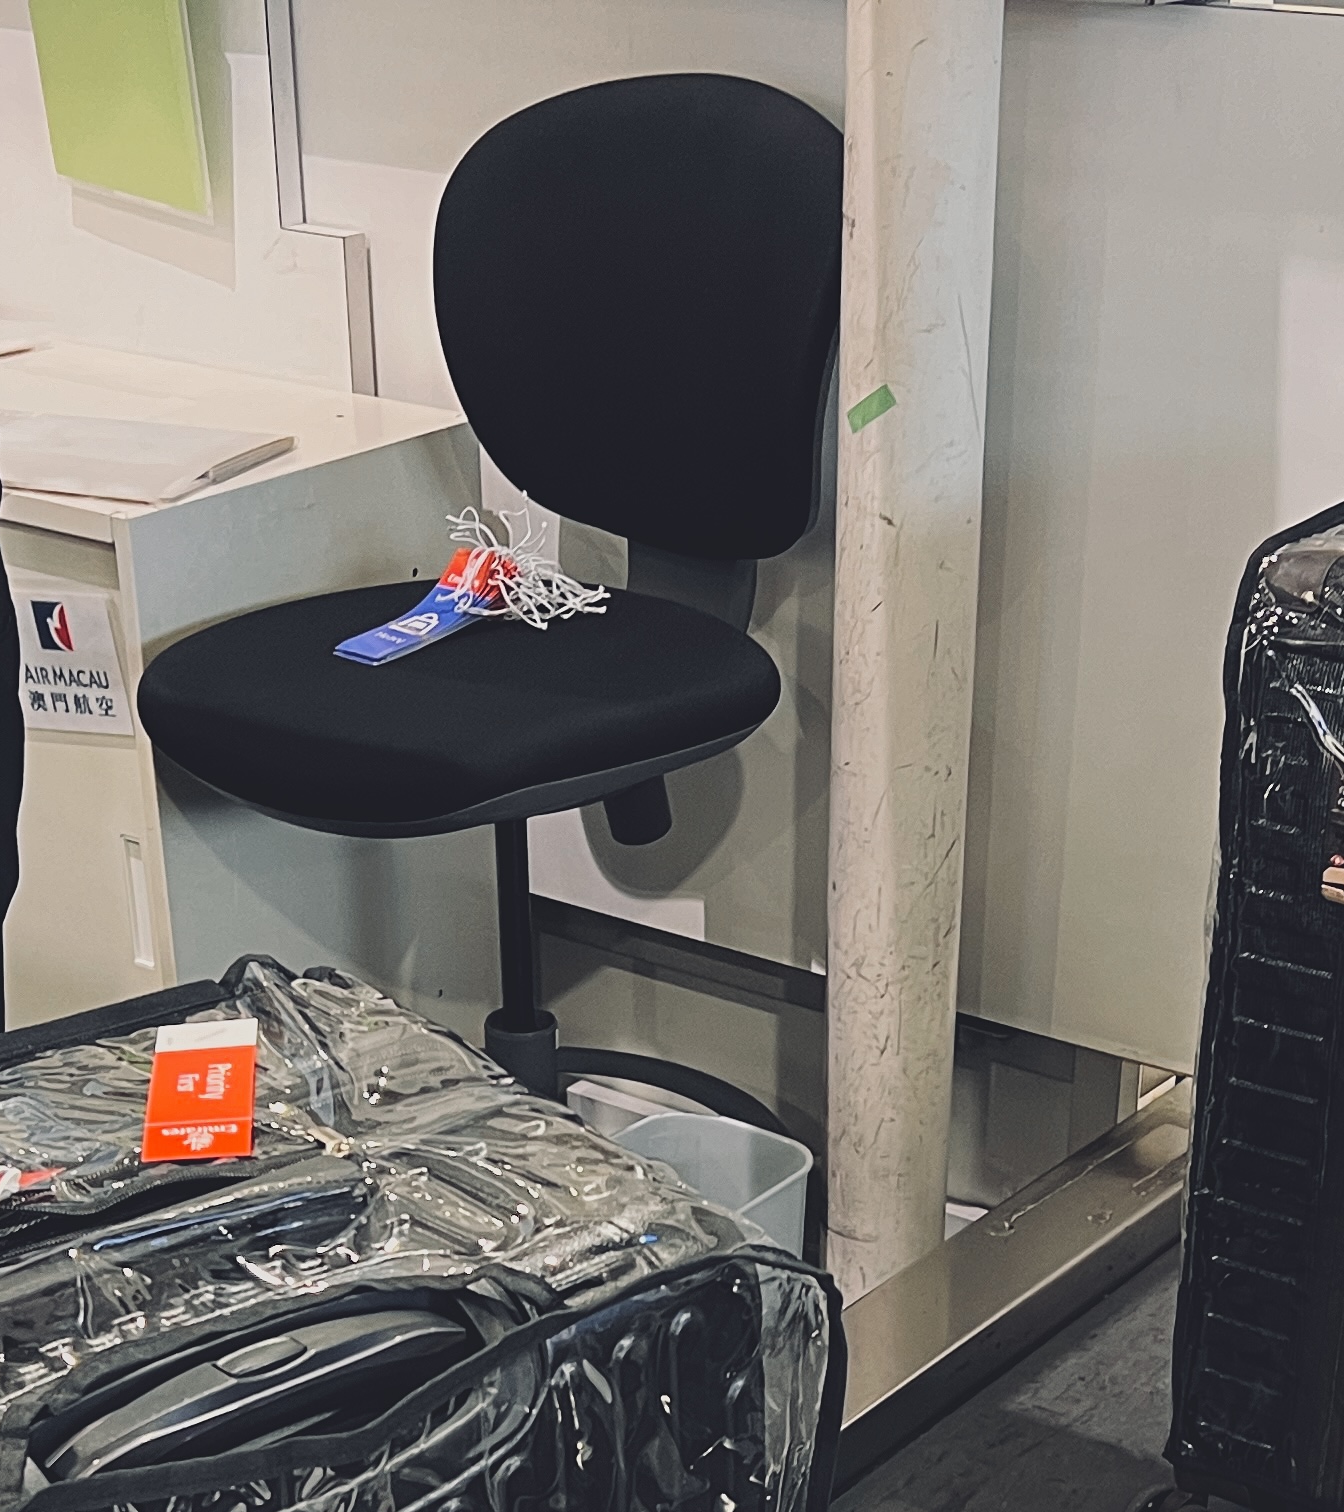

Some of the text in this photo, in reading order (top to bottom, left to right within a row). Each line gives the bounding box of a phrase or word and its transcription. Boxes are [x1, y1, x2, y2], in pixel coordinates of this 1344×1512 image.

[24, 664, 110, 690] AIR MACAU
[28, 689, 117, 717] 澳門航空
